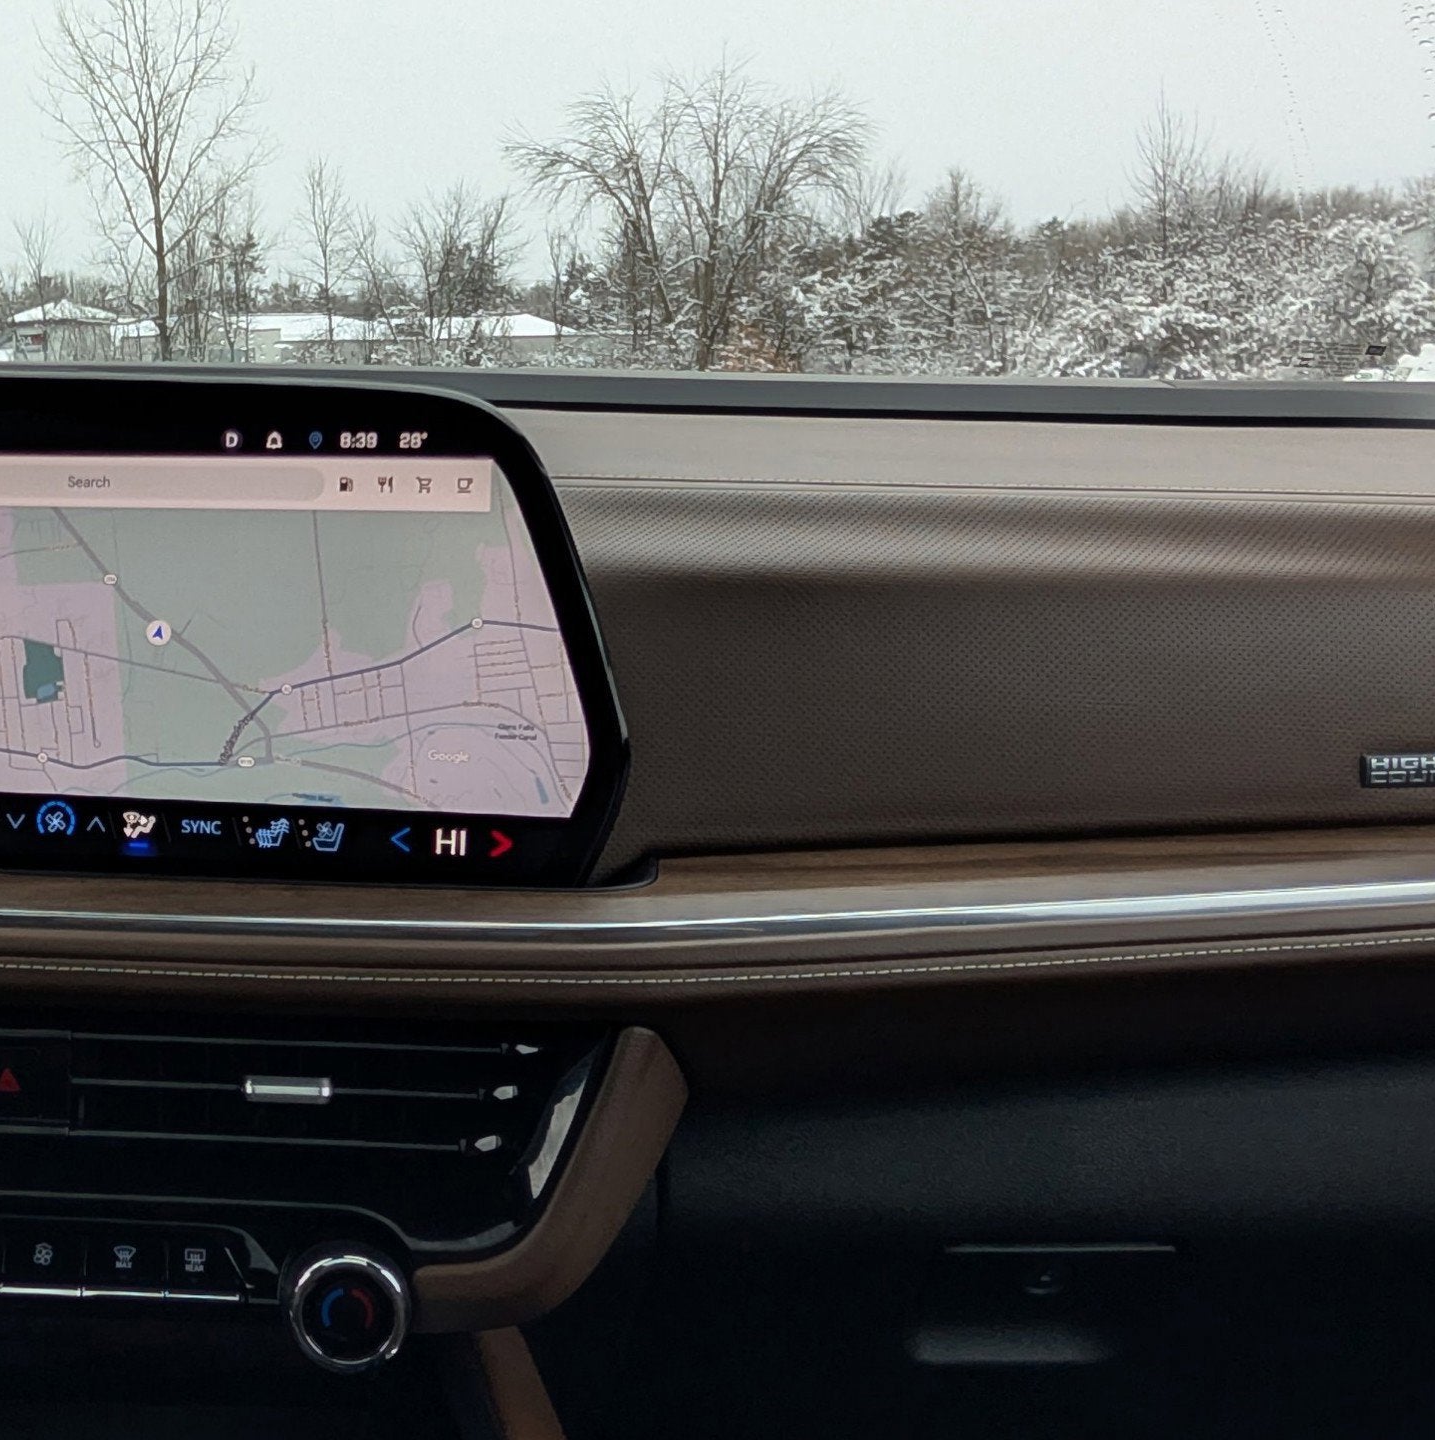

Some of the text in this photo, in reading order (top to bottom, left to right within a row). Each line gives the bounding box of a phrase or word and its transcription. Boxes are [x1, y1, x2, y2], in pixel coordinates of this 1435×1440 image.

[339, 431, 379, 449] 8:39
[67, 475, 111, 489] Search
[427, 749, 471, 764] Google
[180, 819, 222, 836] SYNC
[435, 827, 467, 857] HI
